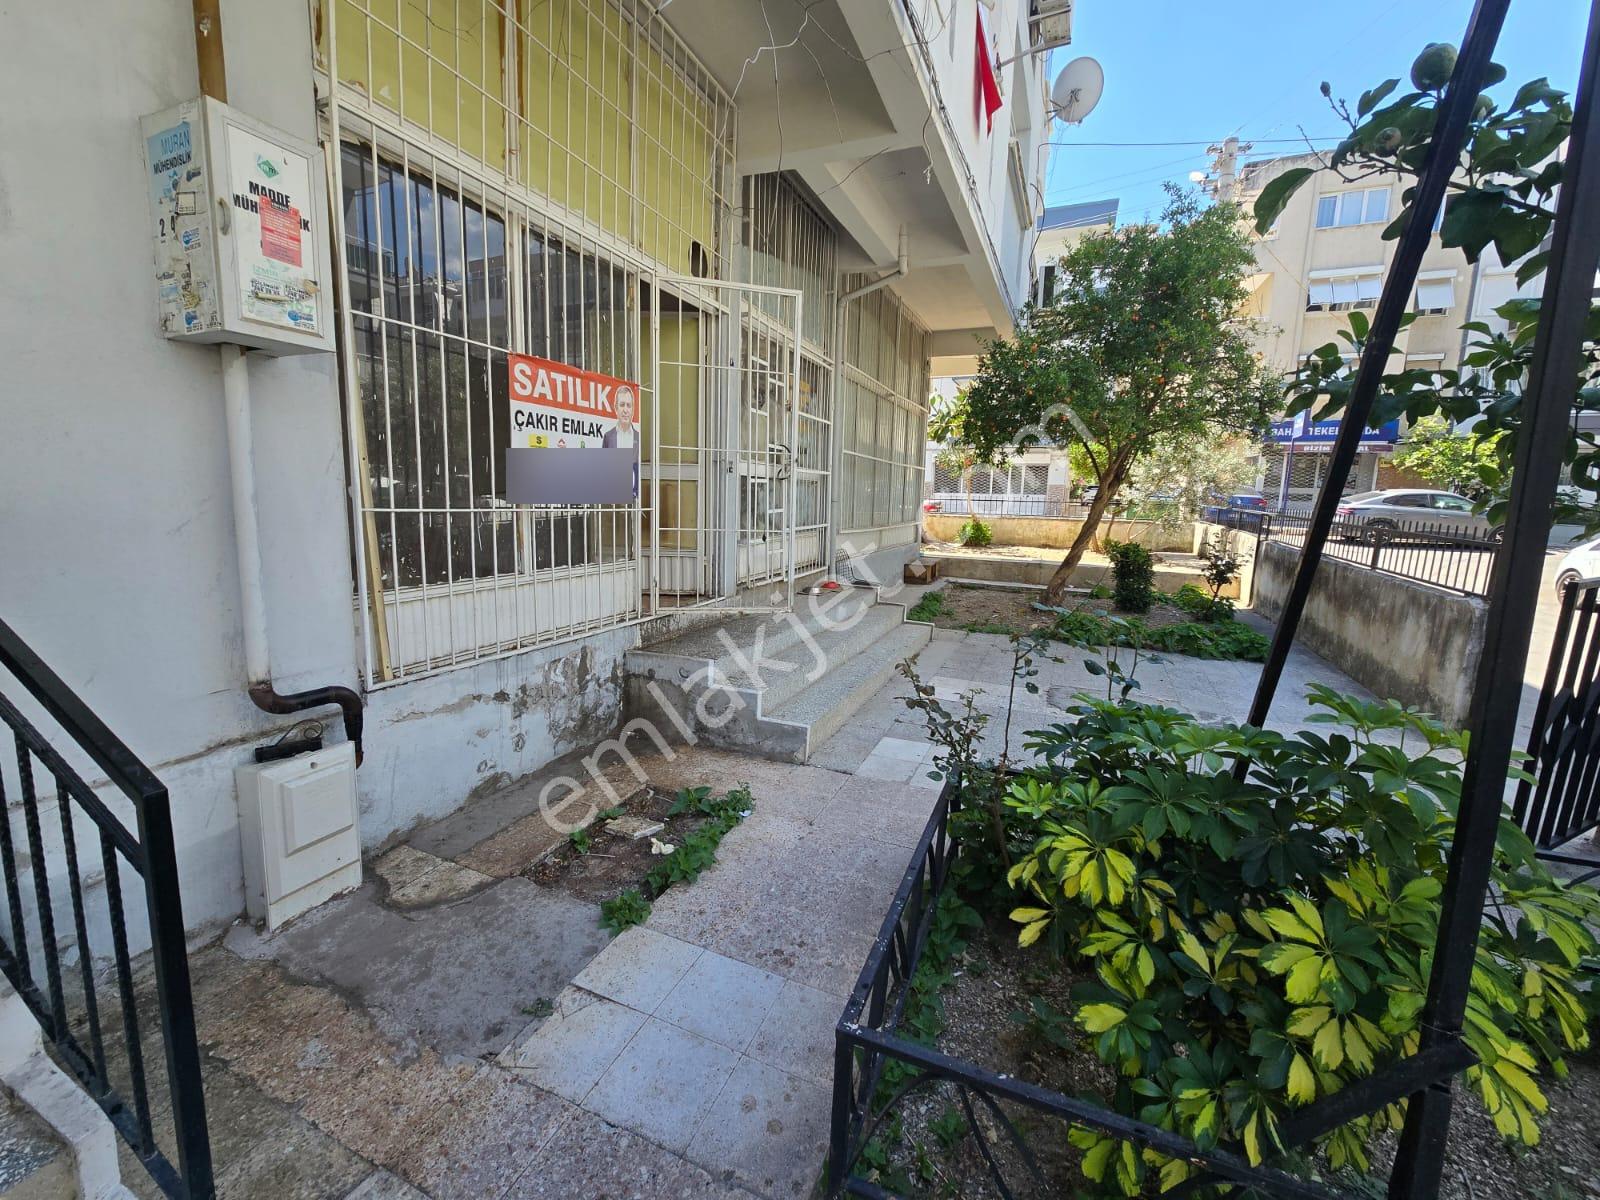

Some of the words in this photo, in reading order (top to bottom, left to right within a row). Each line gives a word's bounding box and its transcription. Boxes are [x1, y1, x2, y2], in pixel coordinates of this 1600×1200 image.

[161, 129, 190, 156] MURAN
[513, 362, 613, 413] SATILIK
[514, 409, 558, 432] ÇAKIR
[562, 417, 604, 439] EMLAK
